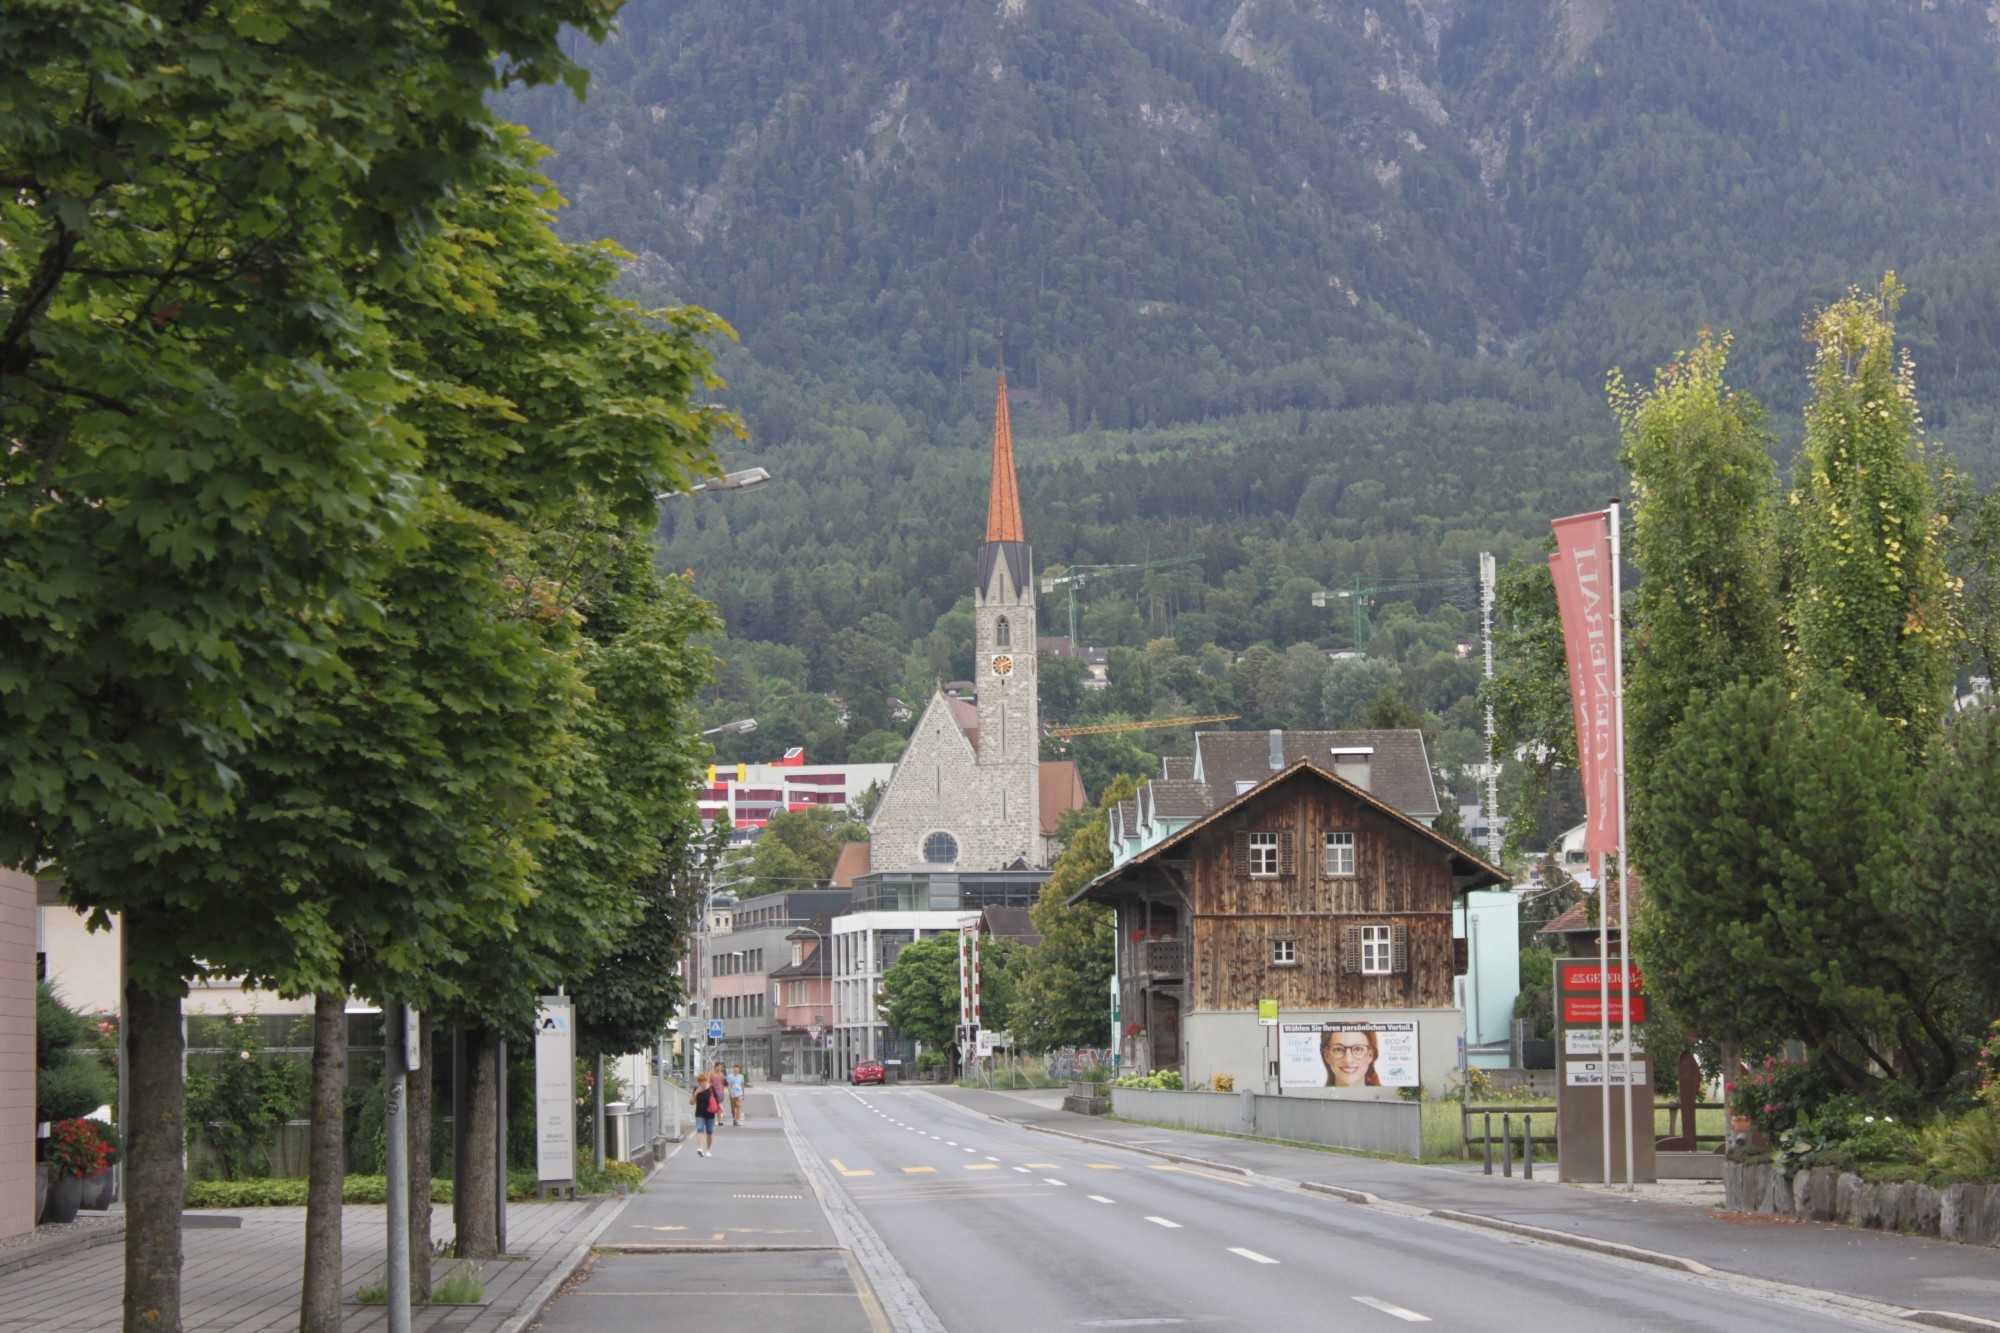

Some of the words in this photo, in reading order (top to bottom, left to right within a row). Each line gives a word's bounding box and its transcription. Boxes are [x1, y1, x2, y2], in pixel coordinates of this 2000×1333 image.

[1586, 973, 1636, 983] GEERI
[1285, 1024, 1310, 1032] Wählen
[1311, 1024, 1322, 1032] Sie
[1323, 1024, 1340, 1032] Ihren
[1342, 1023, 1386, 1033] persönlichen
[1387, 1023, 1412, 1031] Vorteil.
[1390, 1045, 1411, 1053] nomy
[1574, 1074, 1590, 1082] Menü
